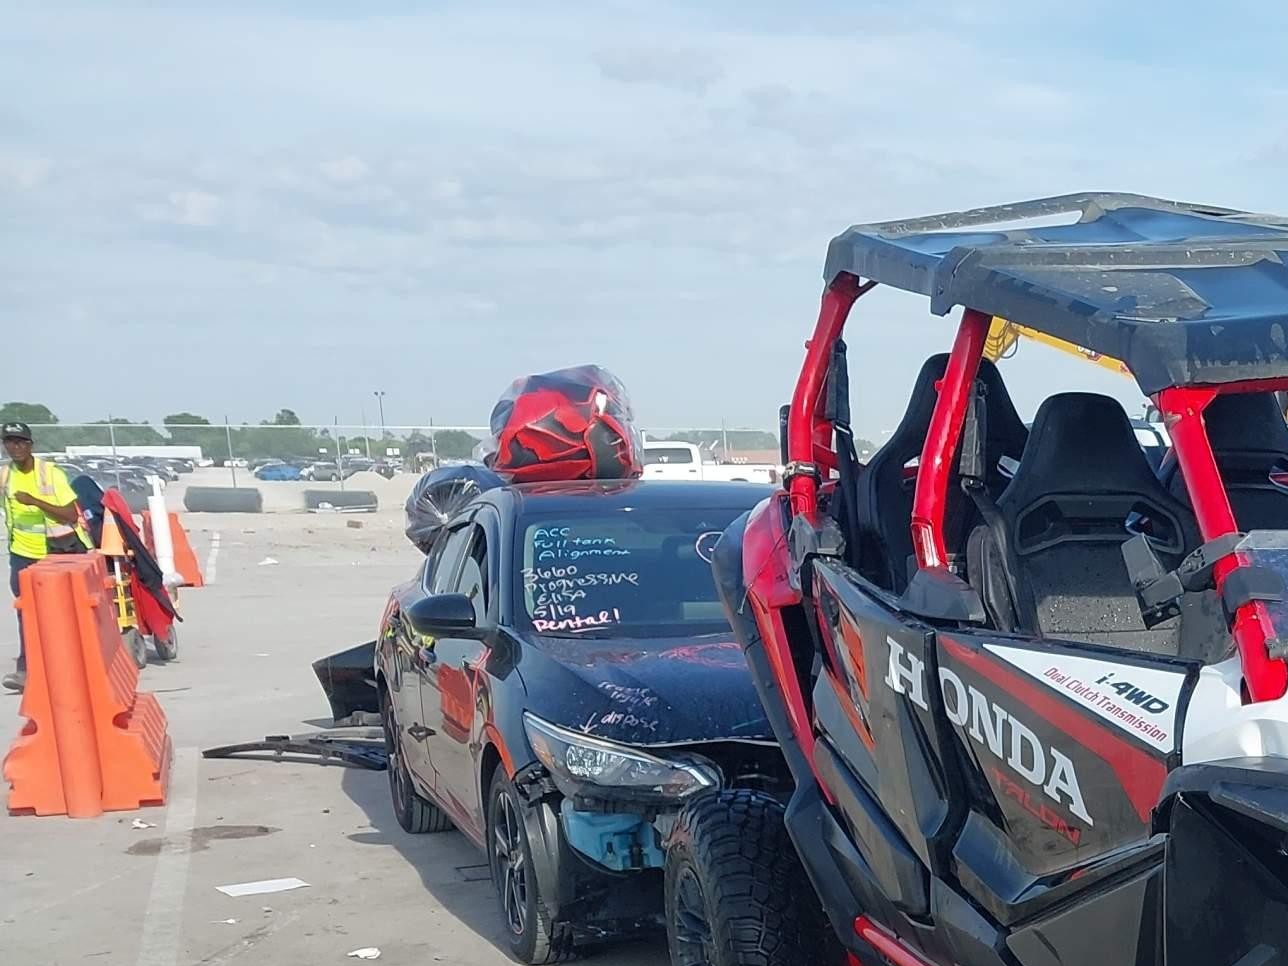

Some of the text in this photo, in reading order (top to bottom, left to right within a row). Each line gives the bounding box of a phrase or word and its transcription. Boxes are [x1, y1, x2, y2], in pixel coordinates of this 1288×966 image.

[534, 527, 570, 539] ACC
[520, 565, 577, 581] 3660
[1043, 667, 1168, 742] Dual Clutch Transmission
[1095, 673, 1169, 714] i-4WD
[885, 636, 1094, 827] HONDA
